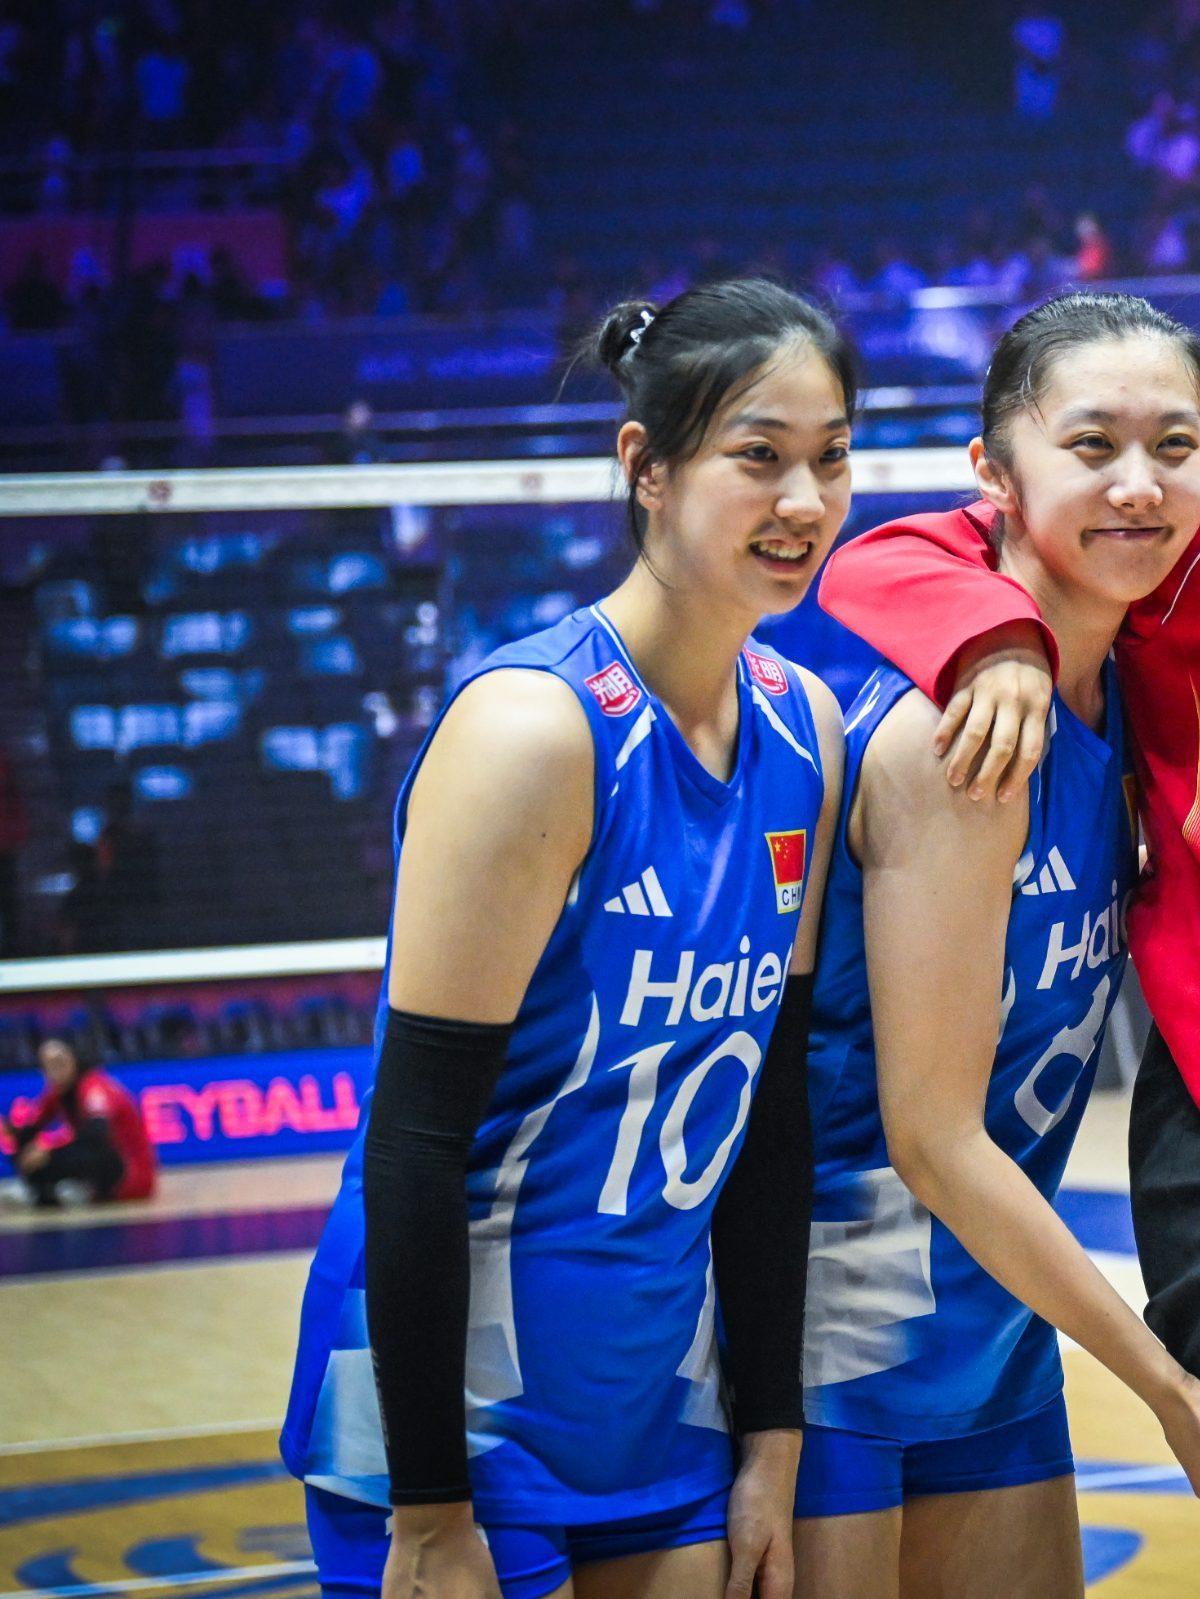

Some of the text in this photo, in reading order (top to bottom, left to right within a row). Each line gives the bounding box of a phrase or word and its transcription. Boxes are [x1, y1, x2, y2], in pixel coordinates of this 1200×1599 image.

[589, 665, 635, 706] 光明
[781, 888, 801, 907] CH
[1036, 879, 1130, 990] Hai
[597, 1030, 762, 1216] 10
